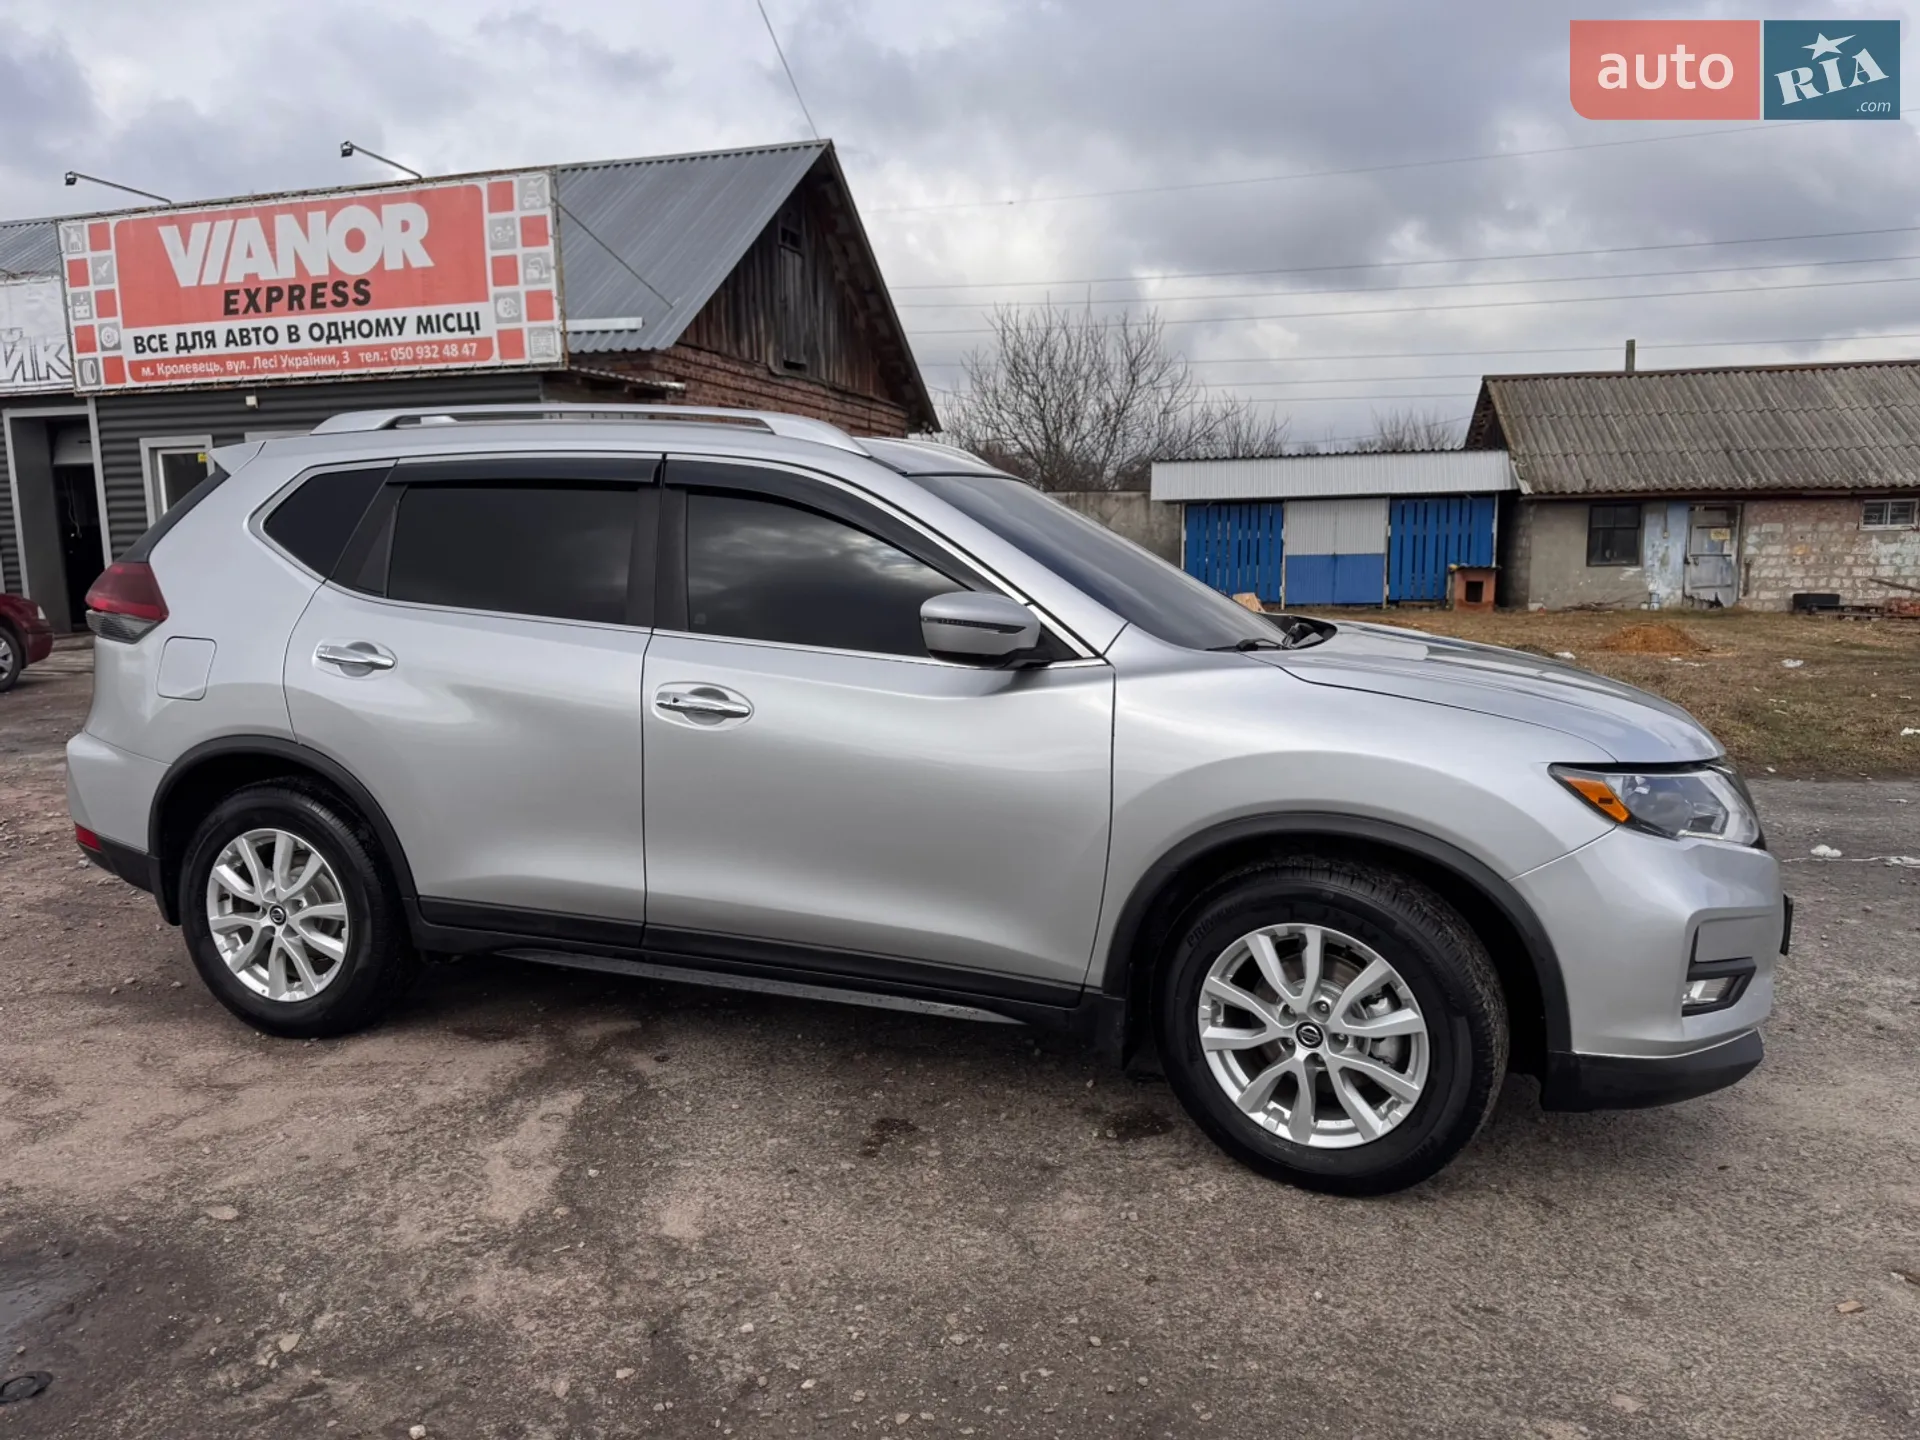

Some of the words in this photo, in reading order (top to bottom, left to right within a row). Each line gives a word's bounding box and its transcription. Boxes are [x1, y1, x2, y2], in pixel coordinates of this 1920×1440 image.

[158, 202, 435, 288] VIANOR
[223, 278, 371, 316] EXPRESS
[133, 333, 169, 354] ВСЕ
[175, 330, 217, 354] ДЛЯ
[225, 325, 279, 348] АВТО
[287, 324, 301, 344] В
[308, 316, 407, 345] ОДНОМУ
[416, 311, 481, 335] МІСЦІ
[141, 366, 155, 377] м.
[156, 361, 224, 378] Кролевець,
[226, 359, 250, 375] вул.
[253, 354, 279, 370] Лесі
[280, 352, 340, 370] Українки,
[341, 351, 350, 364] 3
[358, 350, 388, 363] тел.:
[390, 347, 414, 361] 050
[416, 345, 439, 359] 932
[442, 343, 459, 357] 48
[462, 342, 478, 357] 47
